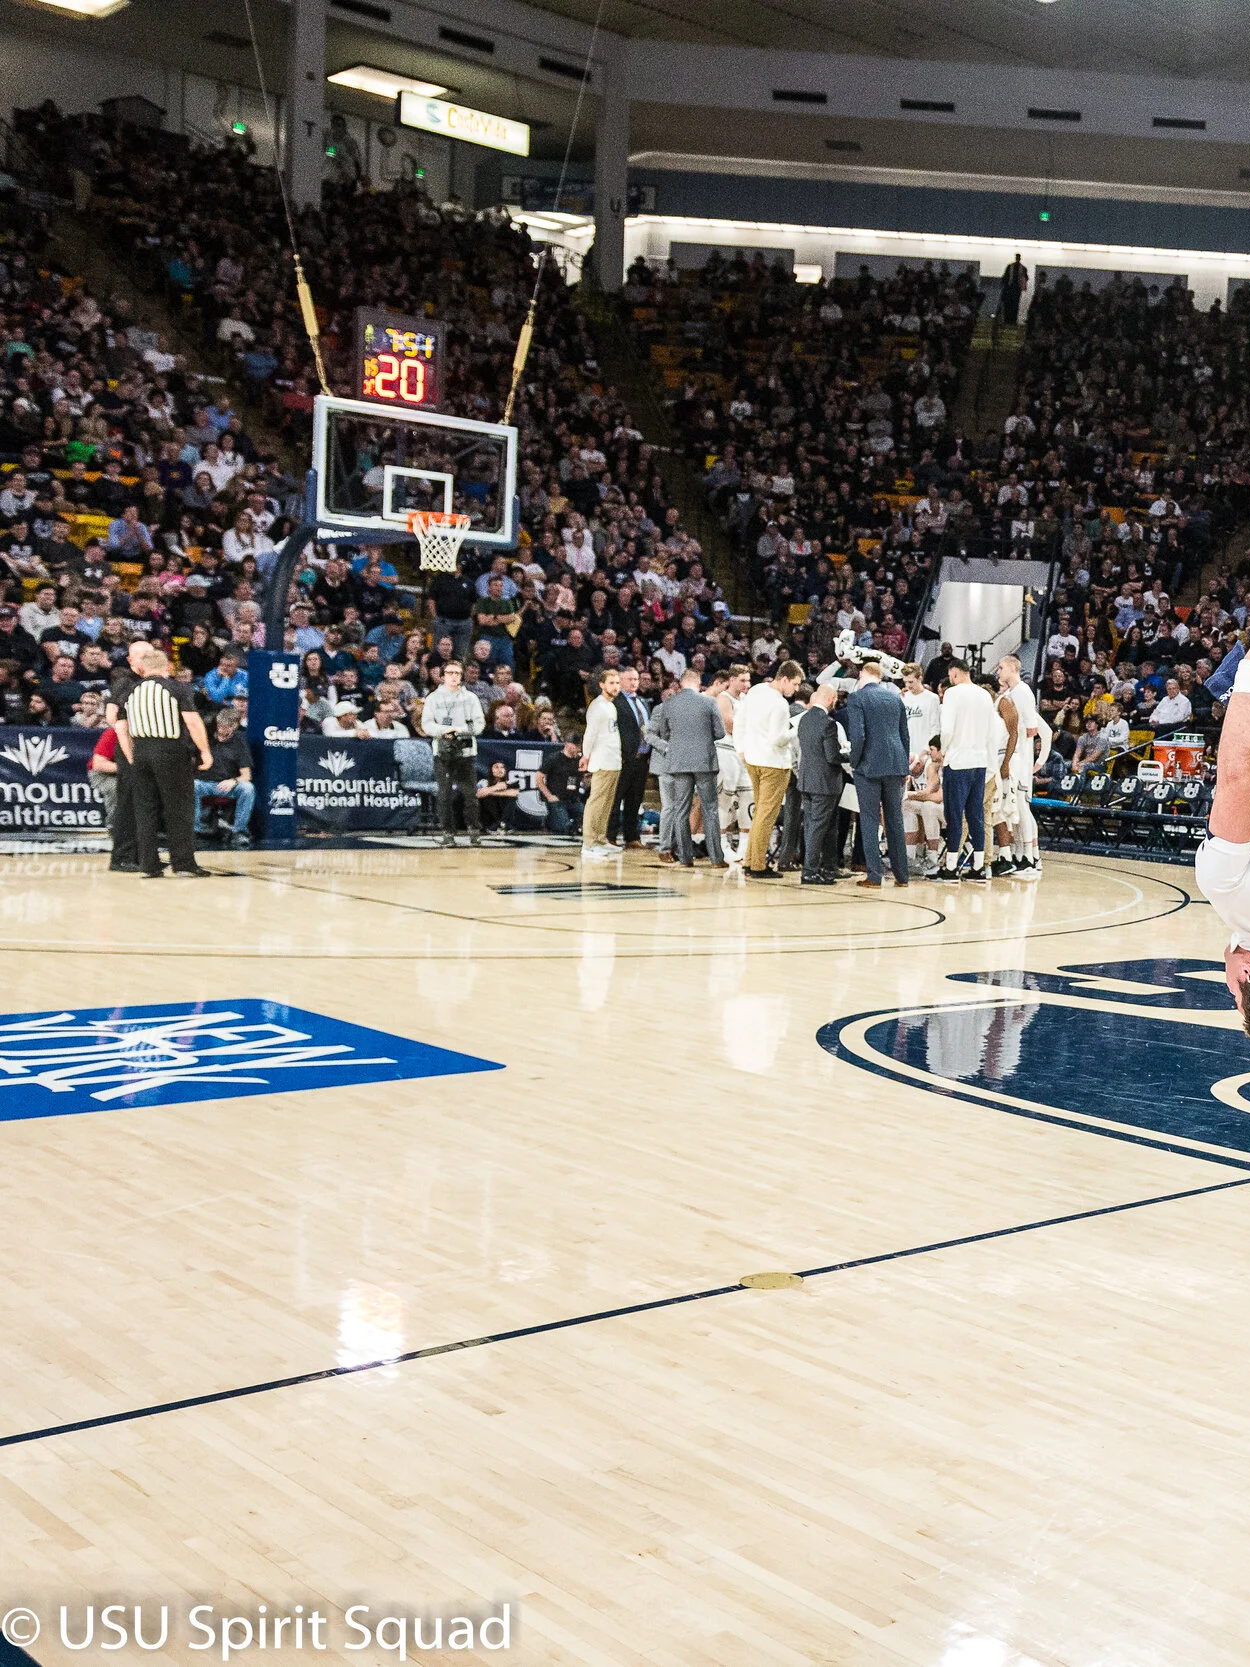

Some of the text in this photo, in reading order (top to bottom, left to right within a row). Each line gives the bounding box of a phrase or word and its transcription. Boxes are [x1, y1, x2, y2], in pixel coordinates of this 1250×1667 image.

[375, 354, 425, 402] 20
[298, 793, 361, 810] Regional
[0, 804, 103, 826] althcare
